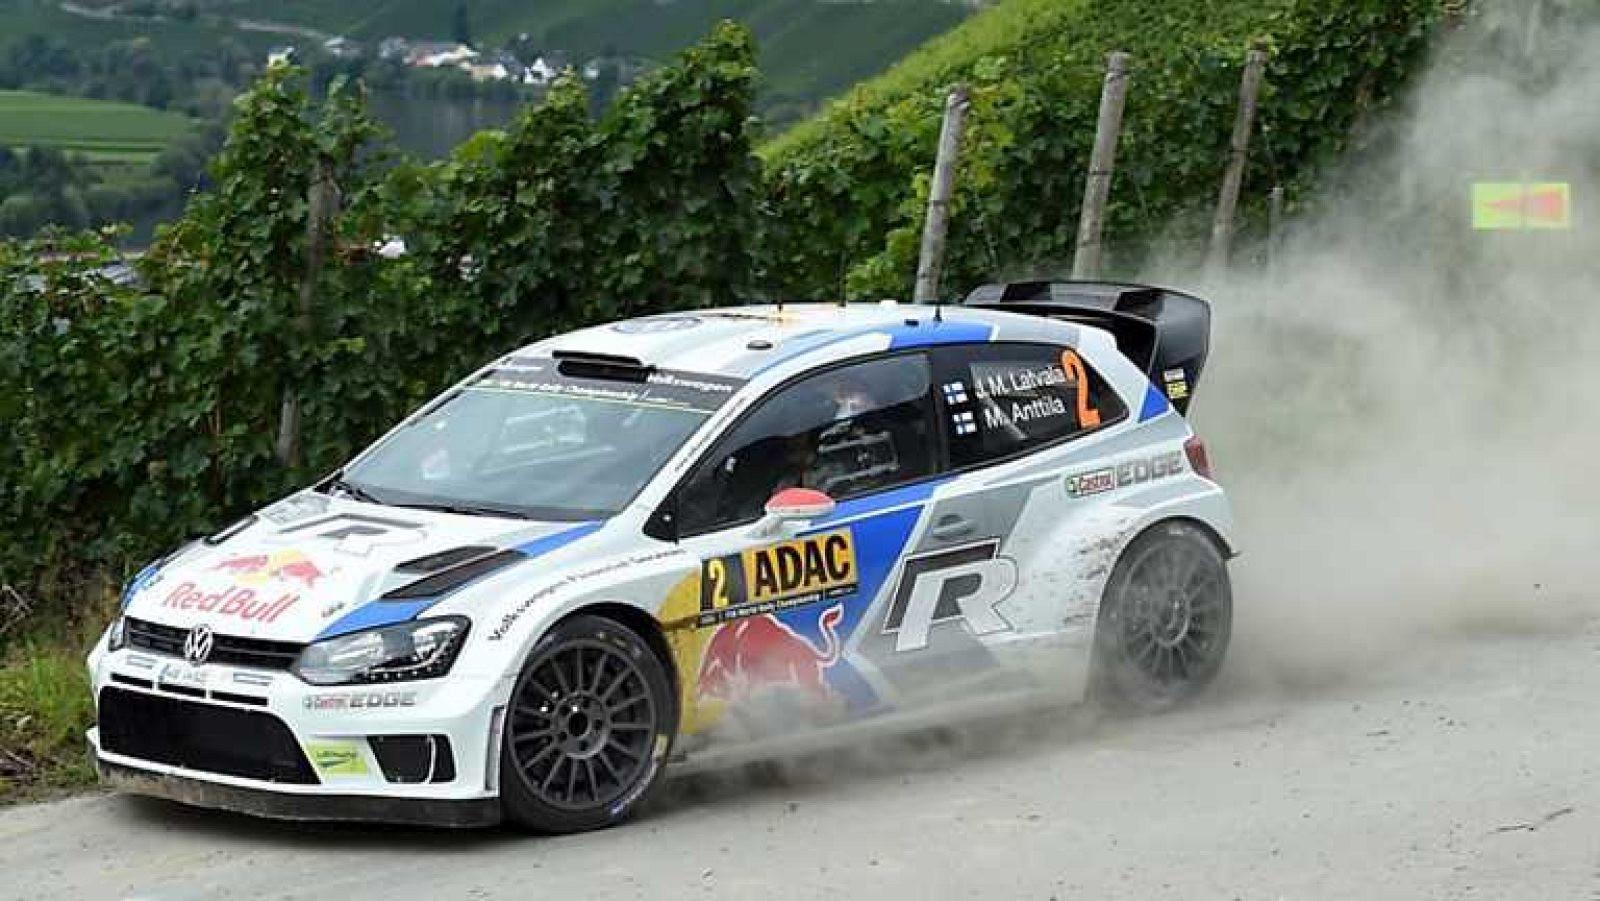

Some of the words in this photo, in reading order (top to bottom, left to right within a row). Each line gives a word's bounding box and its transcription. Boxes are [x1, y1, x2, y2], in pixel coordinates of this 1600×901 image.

[988, 374, 1009, 395] M.
[1061, 349, 1100, 429] 2
[984, 404, 1009, 429] M.
[1011, 395, 1067, 423] Anttila
[1116, 453, 1183, 486] EDGE
[707, 557, 731, 607] 2
[753, 534, 853, 598] ADAC
[162, 581, 227, 613] Red
[224, 588, 299, 624] Bull
[487, 577, 567, 641] Volkswagen
[887, 545, 1017, 651] R
[350, 691, 417, 708] EDGE
